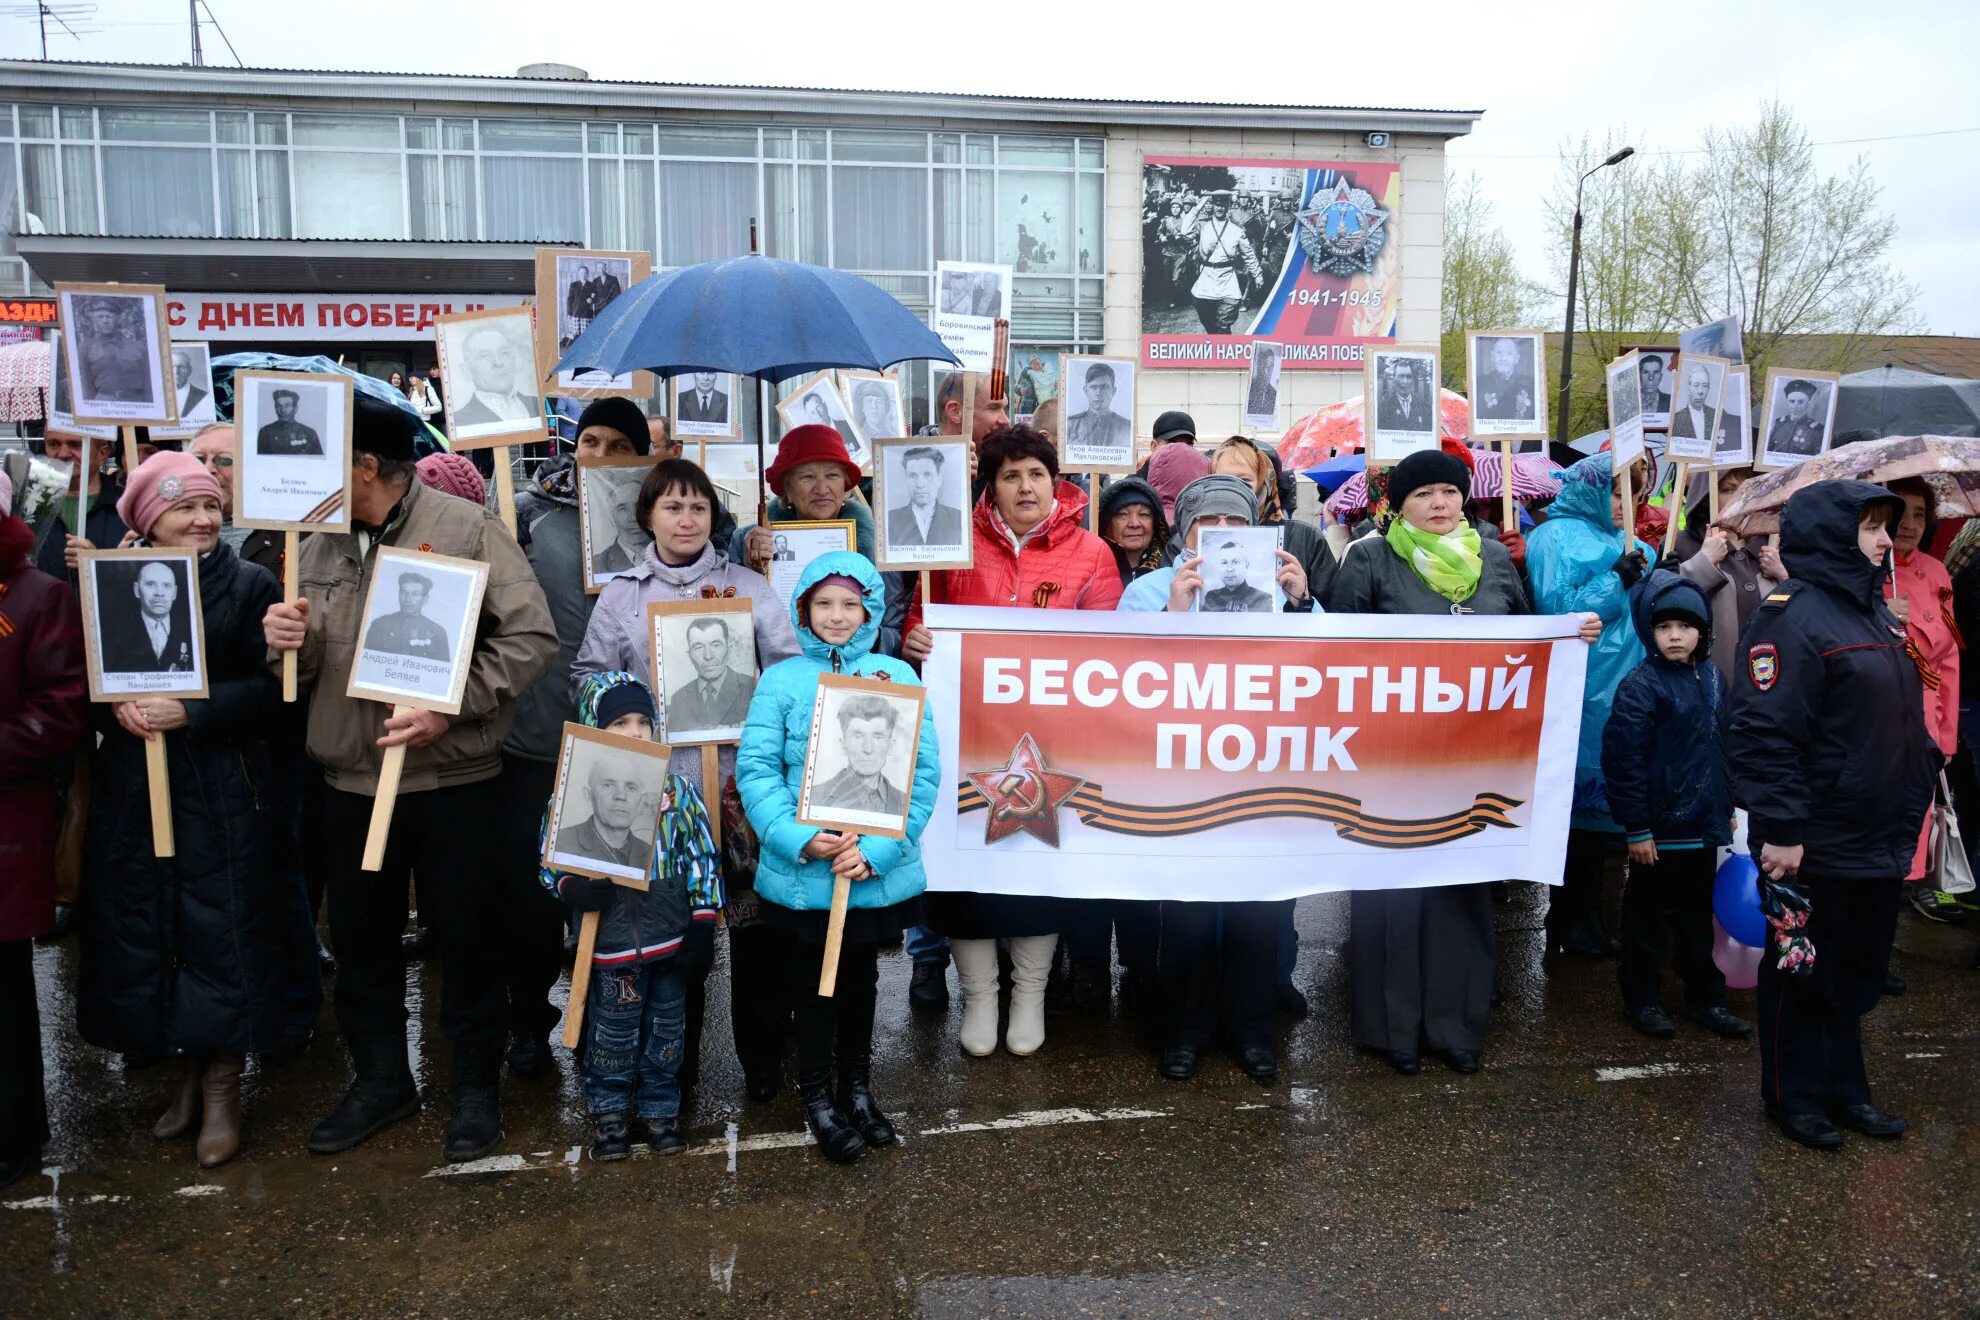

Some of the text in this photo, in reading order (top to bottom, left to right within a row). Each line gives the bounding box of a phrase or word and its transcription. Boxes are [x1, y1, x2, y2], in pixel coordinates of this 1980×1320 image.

[1287, 289, 1382, 306] 1941-1945
[168, 302, 485, 331] С ДНЕМ ПОБЕД
[951, 347, 988, 356] хайлович
[1150, 340, 1213, 360] ВЕЛИКИЙ
[1216, 344, 1252, 361] НАРО
[1331, 345, 1365, 361] ПОБЕ
[260, 486, 327, 495] Андрей Иванович
[362, 651, 451, 675] Андрей Иванович
[105, 672, 193, 681] Степан Трофимович
[384, 668, 420, 683] Беляев
[982, 653, 1534, 714] БЕССМЕРТНЫЙ
[1155, 723, 1360, 773] ПОЛК
